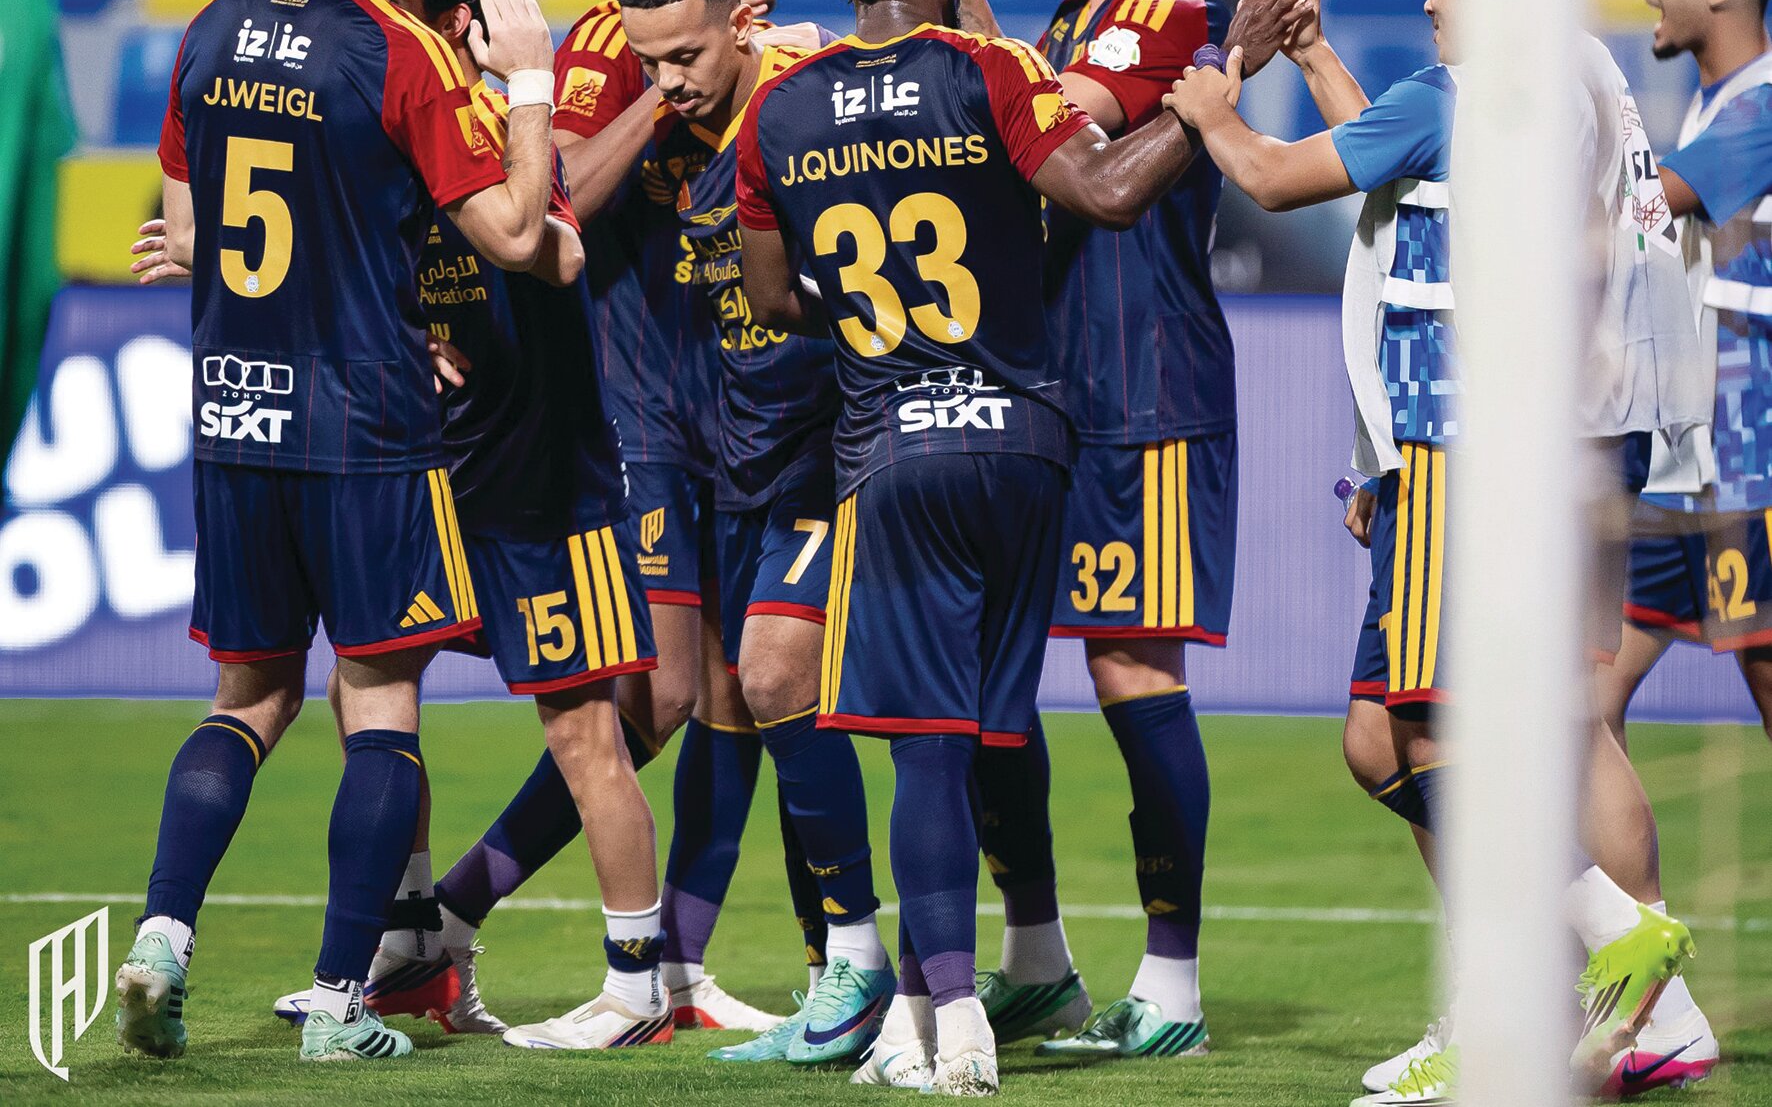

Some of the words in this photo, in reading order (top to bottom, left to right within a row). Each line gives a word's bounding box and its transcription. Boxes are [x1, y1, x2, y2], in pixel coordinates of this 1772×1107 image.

[203, 77, 323, 122] J.WEIGL
[781, 134, 989, 187] J.QUINONES
[220, 135, 294, 298] 5
[419, 284, 487, 305] Aviation
[813, 191, 982, 358] 33
[222, 390, 262, 401] ZOHO
[931, 387, 976, 395] ZOHO
[782, 518, 830, 585] 7
[1070, 540, 1137, 613] 32
[516, 590, 577, 666] 15
